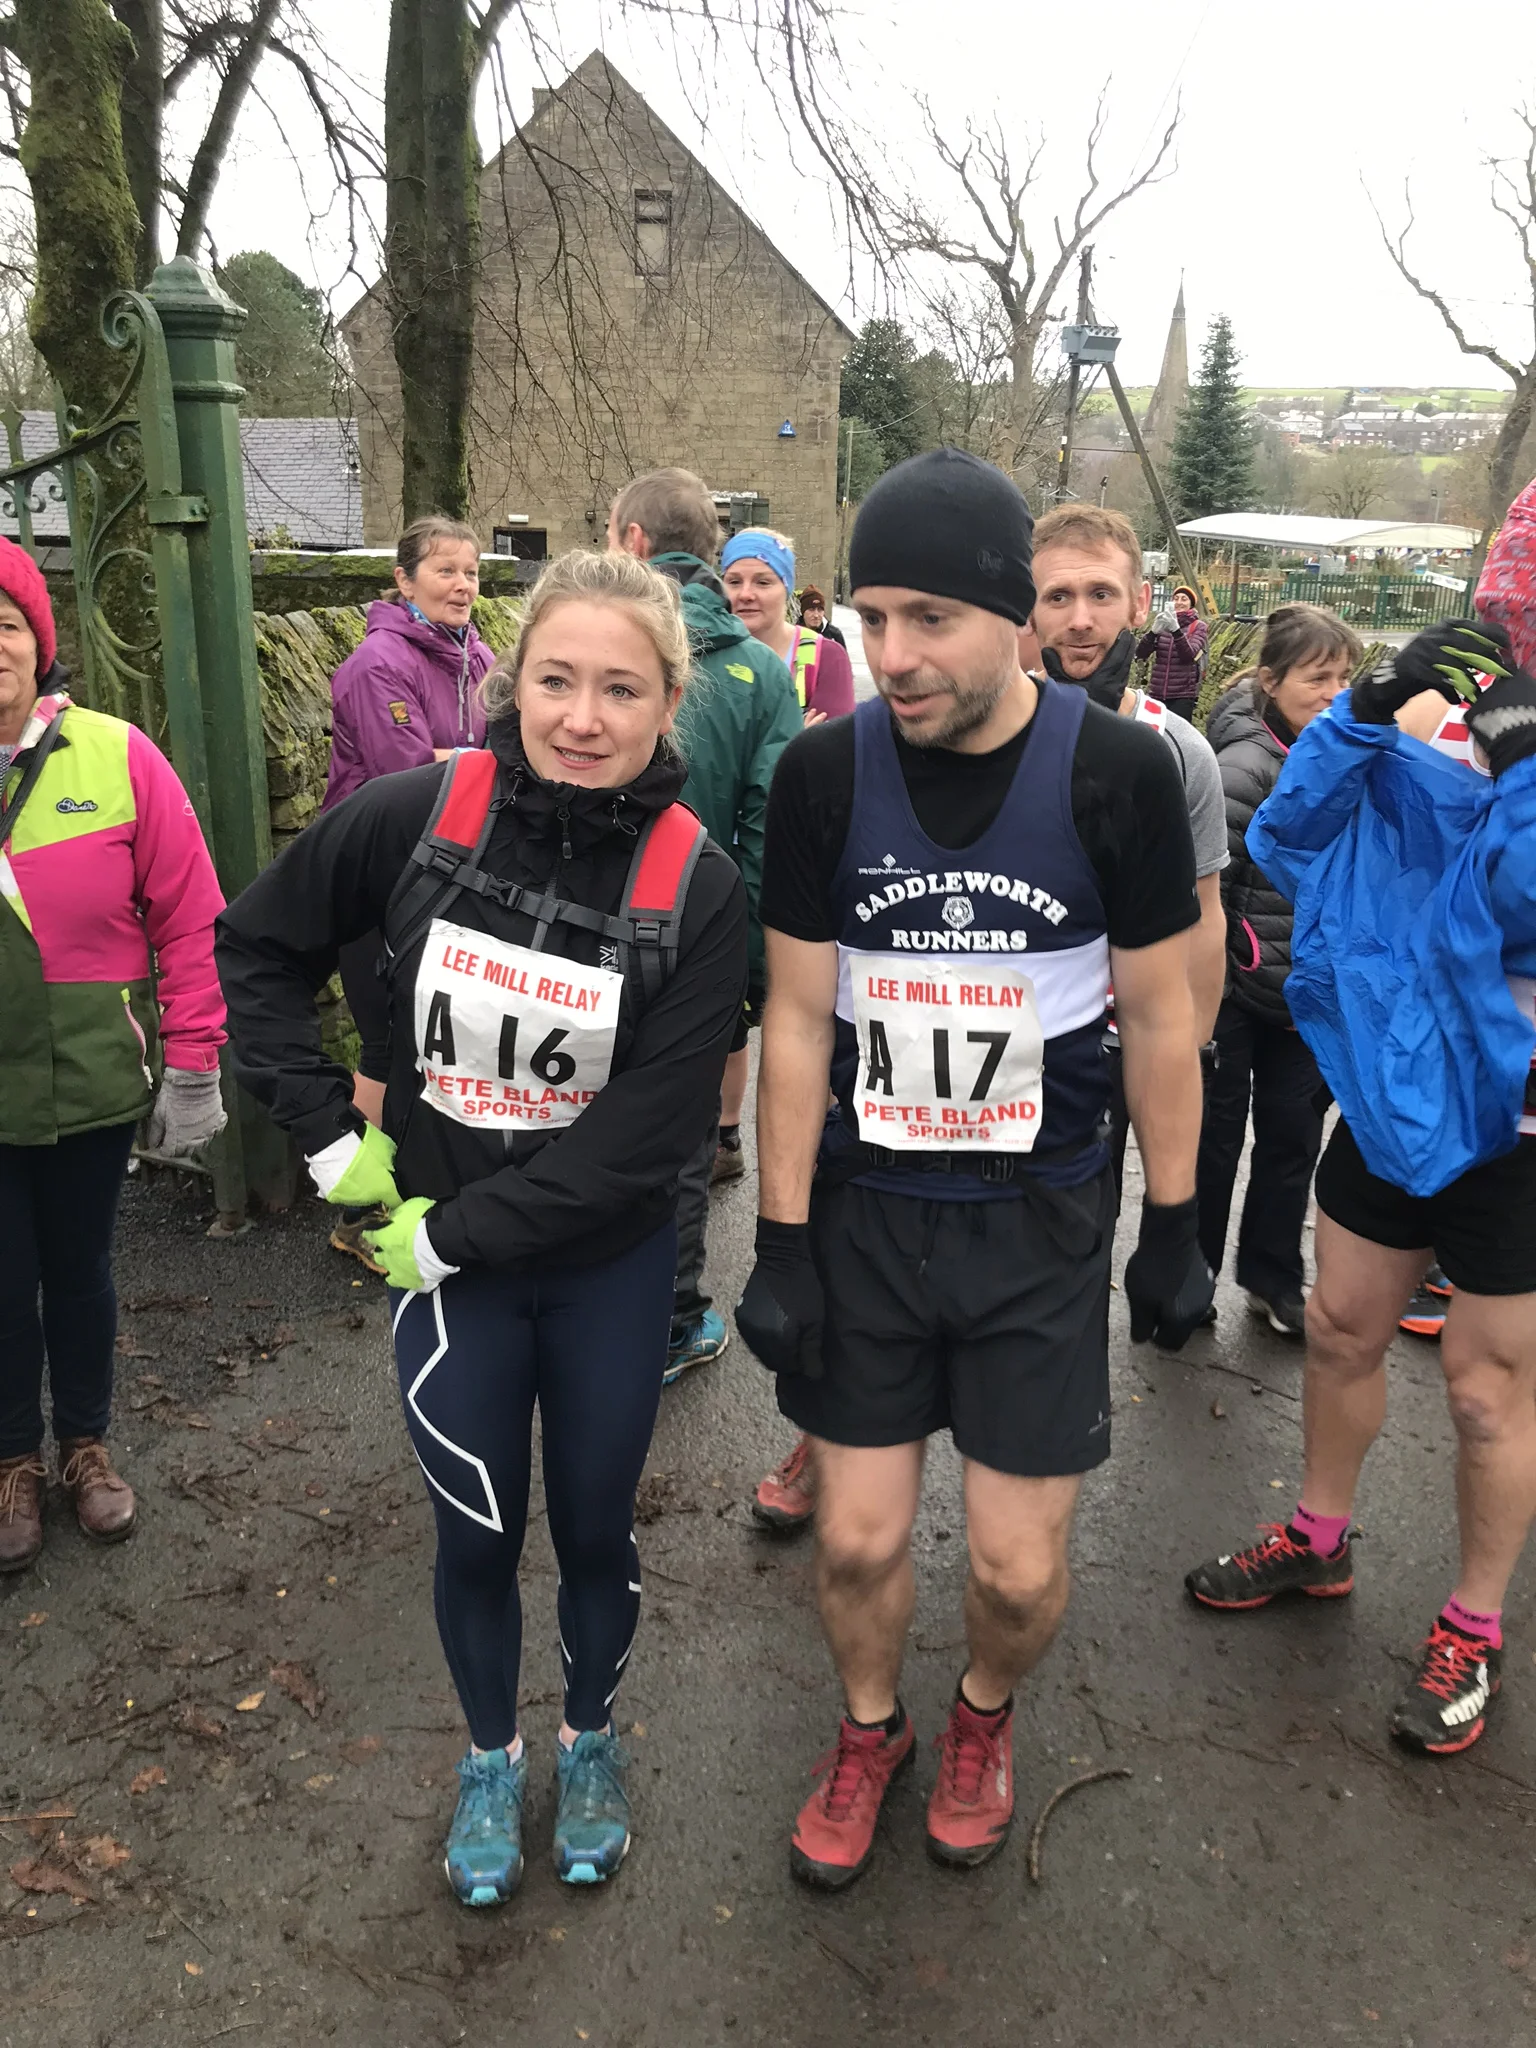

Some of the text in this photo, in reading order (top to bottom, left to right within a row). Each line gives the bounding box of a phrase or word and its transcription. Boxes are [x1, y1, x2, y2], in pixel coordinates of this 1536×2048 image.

[855, 871, 1068, 926] SADDLEWORTH
[892, 930, 1027, 950] RUNNERS
[442, 945, 601, 1011] LEE MILL RELAY
[868, 977, 1024, 1008] LEE MILL RELAY
[424, 990, 576, 1085] A 16
[865, 1019, 1011, 1101] A 17
[426, 1067, 598, 1105] PETE BLAND
[463, 1099, 551, 1119] SPORTS
[864, 1101, 1036, 1126] PETE BLAND
[907, 1124, 990, 1138] SPORTS
